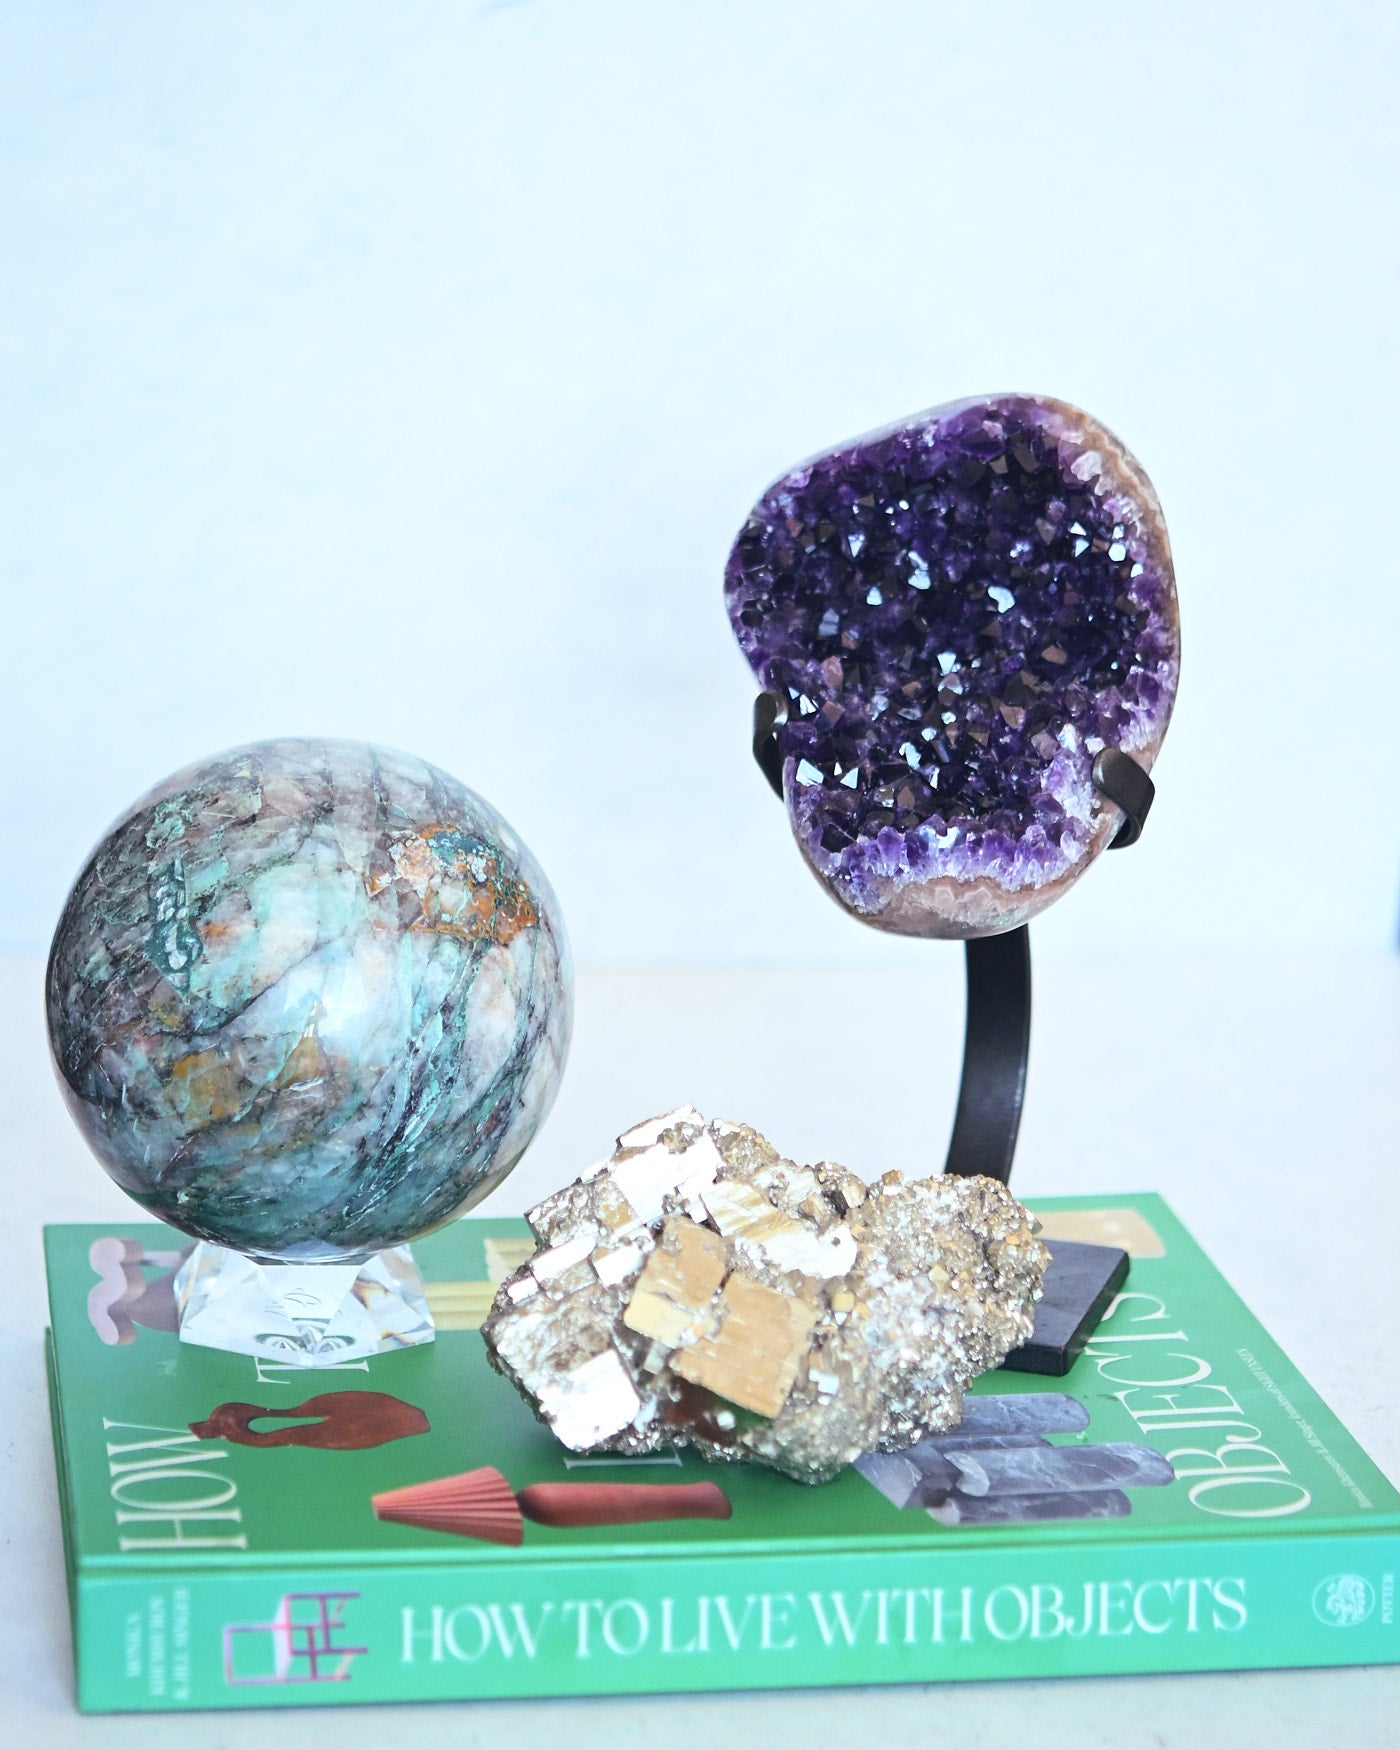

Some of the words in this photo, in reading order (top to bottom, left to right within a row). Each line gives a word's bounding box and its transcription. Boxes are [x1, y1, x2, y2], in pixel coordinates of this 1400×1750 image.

[103, 1417, 248, 1552] HOW
[401, 1601, 555, 1662] HOW
[560, 1599, 649, 1658] TO
[661, 1594, 797, 1654] LIVE
[807, 1586, 974, 1648] WITH
[984, 1577, 1249, 1641] OBJECTS
